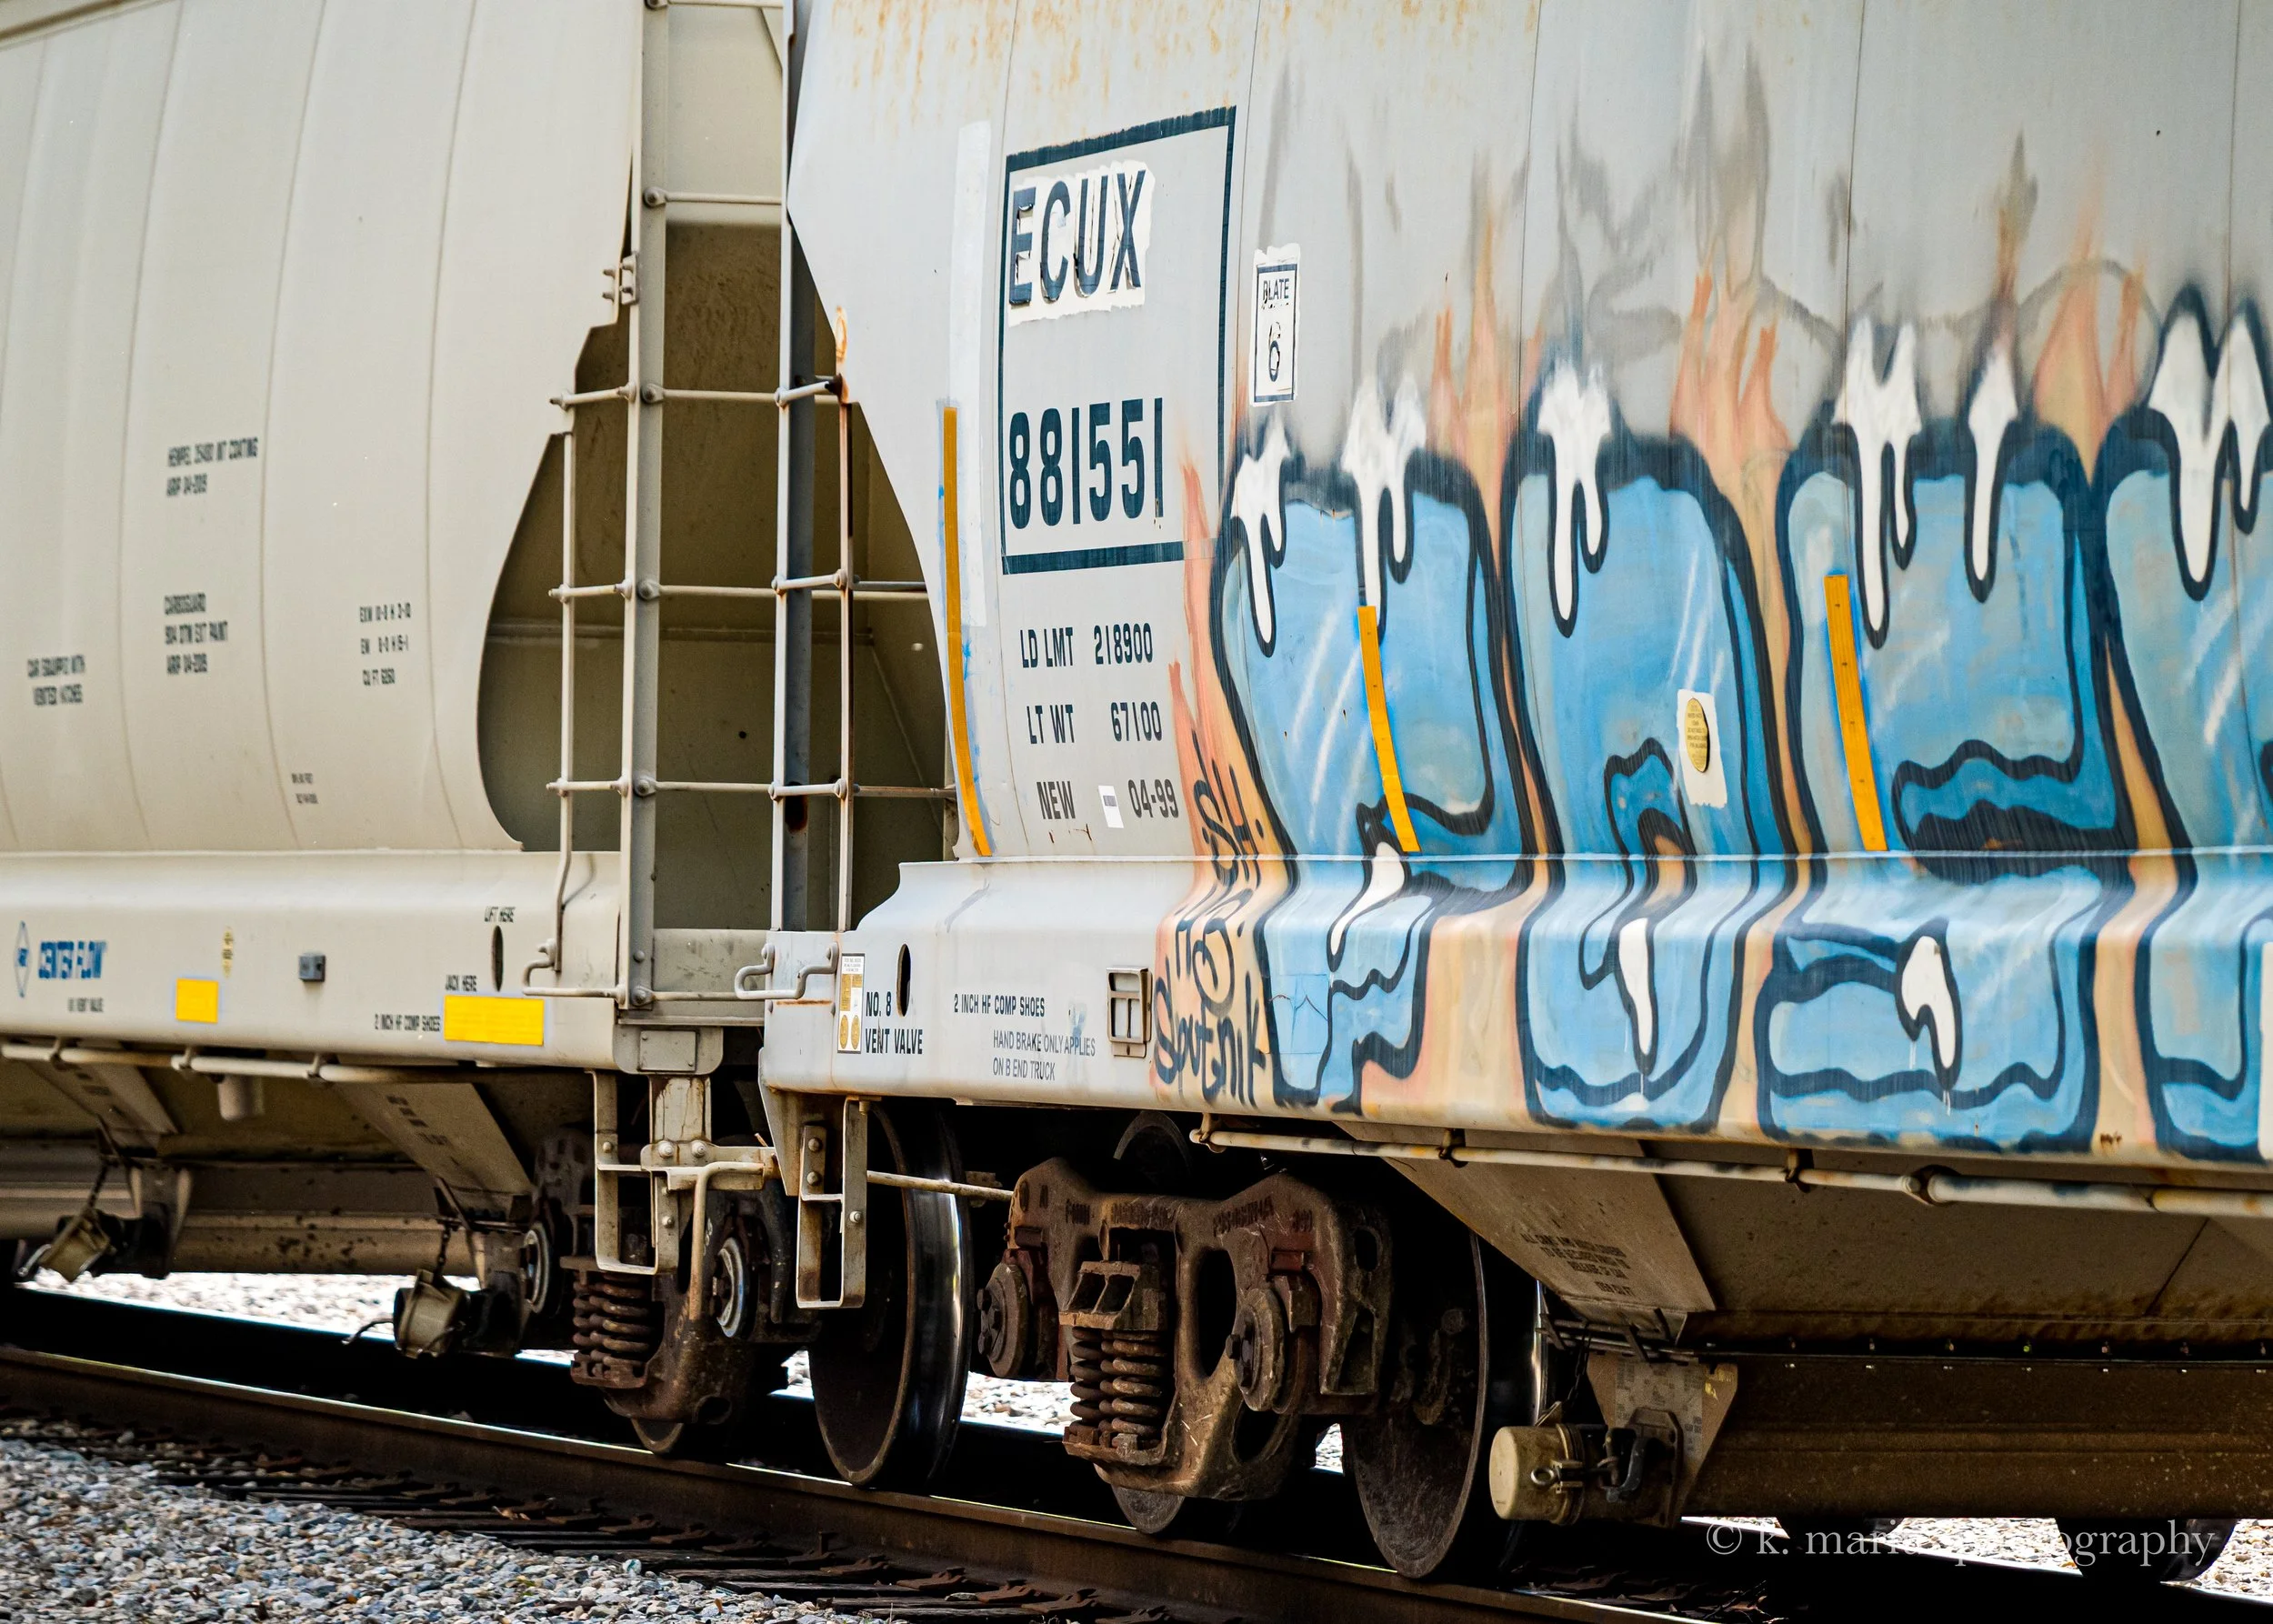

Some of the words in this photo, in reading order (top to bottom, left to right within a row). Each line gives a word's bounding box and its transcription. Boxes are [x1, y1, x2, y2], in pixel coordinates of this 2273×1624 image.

[1008, 169, 1147, 306] ECUX
[1263, 277, 1289, 302] PLATE
[1008, 396, 1164, 530] 881551
[1020, 628, 1038, 668] LD
[1044, 627, 1074, 667] LMT
[1094, 622, 1153, 665] 218900
[1026, 705, 1044, 744] LT
[1050, 704, 1075, 744] WT
[1110, 701, 1162, 743] 67100
[1036, 780, 1076, 820] NEW
[1127, 778, 1179, 818] 04-99
[498, 906, 516, 923] HERE
[462, 976, 476, 992] HERE
[866, 991, 881, 1017] NO.
[886, 990, 892, 1017] 8
[954, 993, 958, 1013] 2
[961, 994, 978, 1014] INCH
[981, 995, 991, 1015] HF
[994, 995, 1016, 1016] COMP
[1019, 996, 1045, 1018] SHOES
[422, 1015, 440, 1032] SHOES
[866, 1028, 890, 1054] VENT
[895, 1028, 923, 1054] VALVE
[993, 1029, 1015, 1049] HAND
[1016, 1032, 1042, 1052] BRAKE
[1043, 1034, 1064, 1054] ONLY
[1064, 1036, 1096, 1057] APPLIES
[993, 1057, 1004, 1076] ON
[1006, 1058, 1010, 1077] B
[1013, 1059, 1027, 1079] END
[1030, 1060, 1056, 1081] TRUCK
